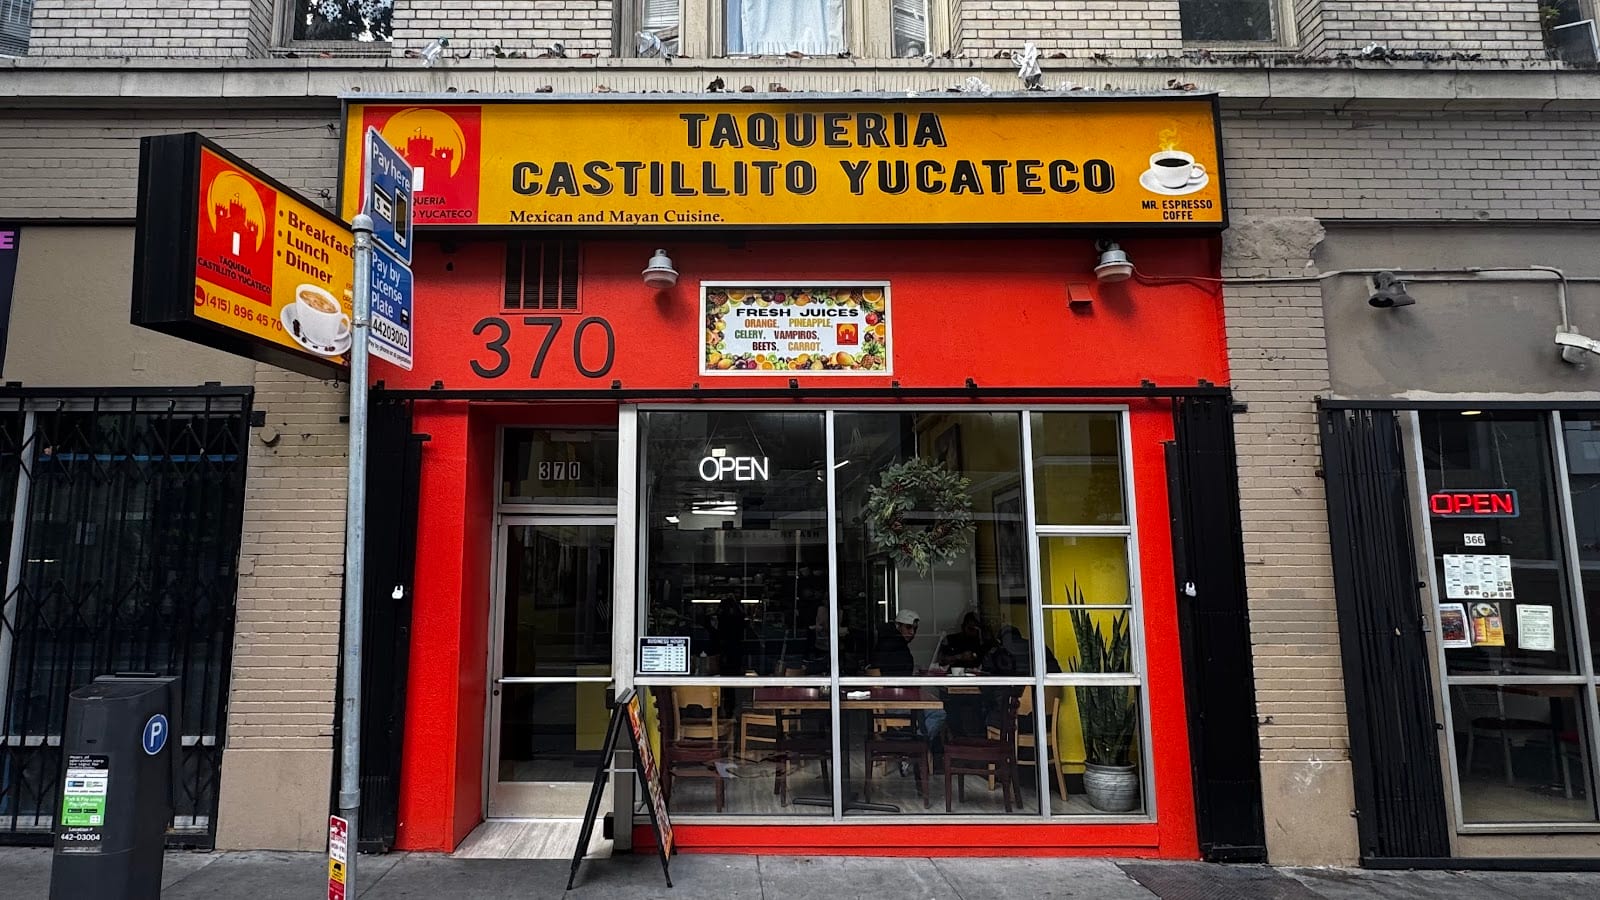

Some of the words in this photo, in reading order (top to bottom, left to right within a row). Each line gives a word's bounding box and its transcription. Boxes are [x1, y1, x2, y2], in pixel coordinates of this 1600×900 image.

[679, 112, 947, 149] TAQUERIA
[373, 142, 390, 175] Pay
[391, 164, 411, 192] here
[512, 160, 817, 197] CASTILLITO
[840, 159, 1116, 196] YUCATECO
[413, 197, 446, 206] QUERIA
[420, 209, 473, 218] YUCATECO
[1162, 199, 1213, 210] ESPRESSO
[1163, 210, 1193, 220] COFFE
[509, 210, 573, 223] Mexican
[577, 210, 604, 223] and
[608, 210, 659, 225] Mayan
[664, 210, 725, 223] Cuisine.
[287, 230, 329, 264] Lunch
[197, 257, 237, 280] CASTILLITO
[238, 273, 271, 294] YUCATECO
[219, 255, 252, 276] TAQUERIA
[286, 250, 333, 284] Dinner
[372, 251, 388, 278] Pay
[390, 262, 400, 287] by
[371, 270, 403, 305] License
[206, 292, 231, 314] (415)
[233, 304, 254, 321] 896
[256, 313, 269, 327] 45
[271, 318, 283, 331] 70
[371, 291, 394, 319] Plate
[736, 308, 791, 317] FRESH
[799, 308, 859, 317] JUICES
[373, 319, 409, 350] 44203002
[469, 316, 616, 379] 370
[538, 461, 581, 481] 370
[699, 456, 769, 482] OPEN
[1430, 493, 1513, 514] OPEN
[1465, 536, 1484, 545] 366
[60, 833, 101, 841] 442-03004
